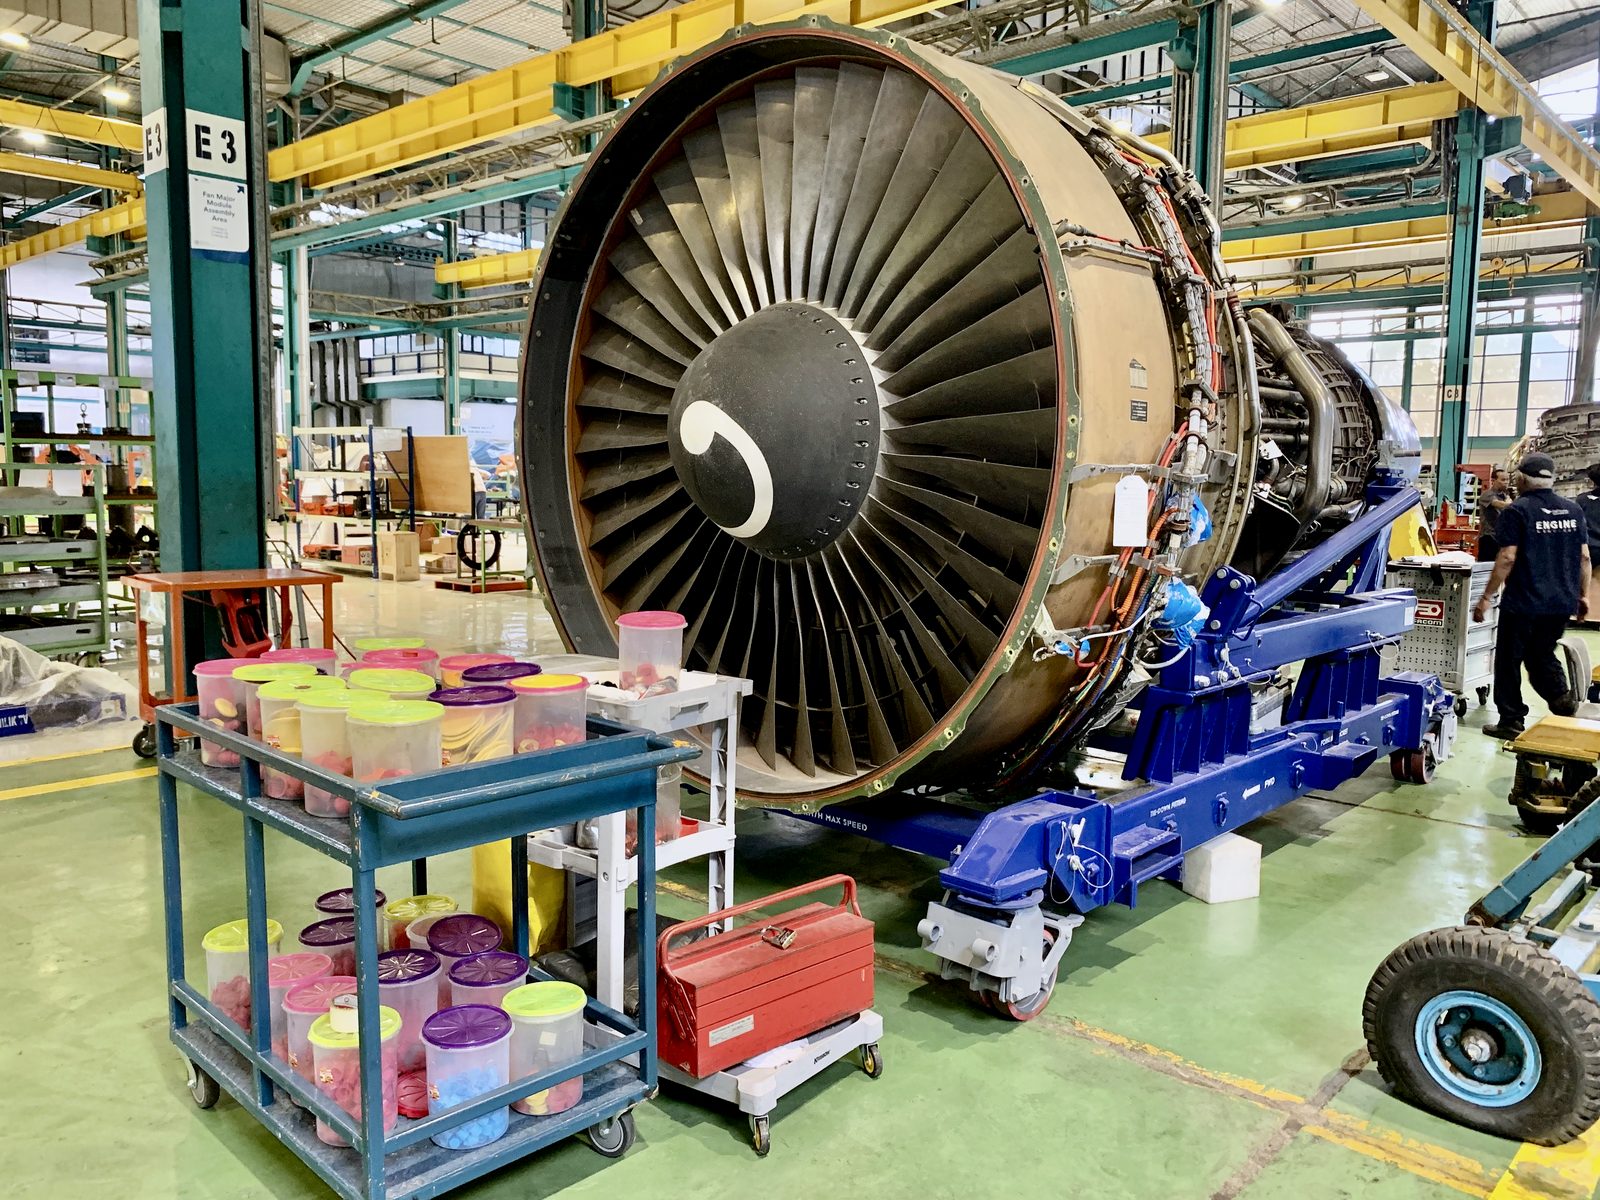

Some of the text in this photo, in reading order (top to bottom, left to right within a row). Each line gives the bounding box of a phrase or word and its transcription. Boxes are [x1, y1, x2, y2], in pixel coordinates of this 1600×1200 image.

[216, 194, 236, 202] Major
[207, 200, 232, 208] Module
[204, 206, 235, 217] Assembly
[1536, 520, 1577, 530] ENGINE
[825, 814, 841, 824] MAX
[842, 818, 868, 831] SPEED
